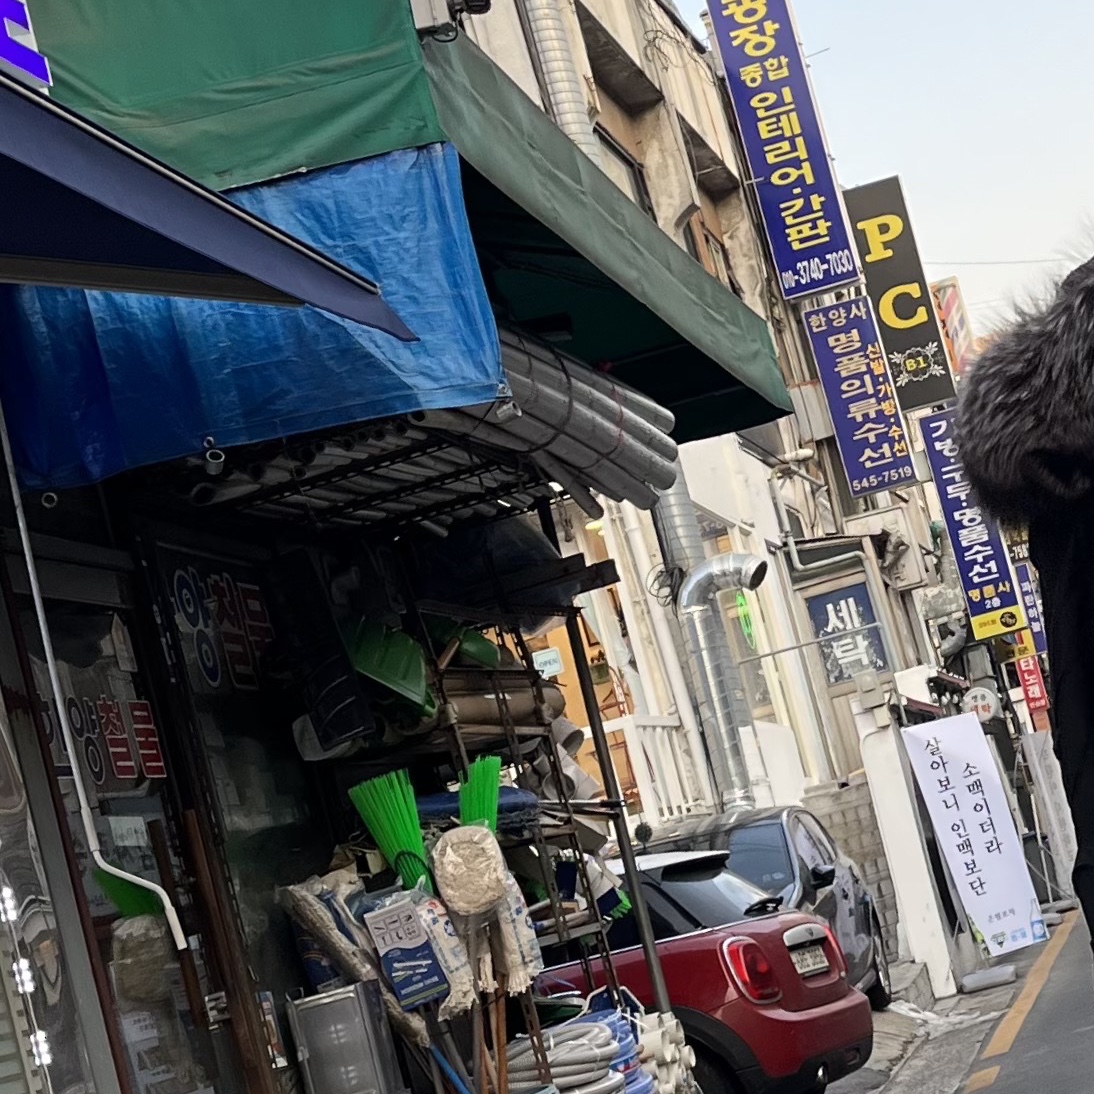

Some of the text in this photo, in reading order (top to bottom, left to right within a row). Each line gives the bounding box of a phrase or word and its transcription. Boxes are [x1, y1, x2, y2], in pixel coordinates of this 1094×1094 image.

[739, 55, 790, 88] 종합
[782, 249, 853, 290] 010-3740-7030
[808, 301, 868, 333] 한양사
[905, 353, 927, 371] B1
[827, 328, 894, 469] 명품의류수선
[852, 465, 913, 492] 545-7519
[824, 597, 870, 665] 세탁
[924, 737, 987, 896] 살아보니 인맥보단
[962, 761, 1003, 855] 소맥이더라
